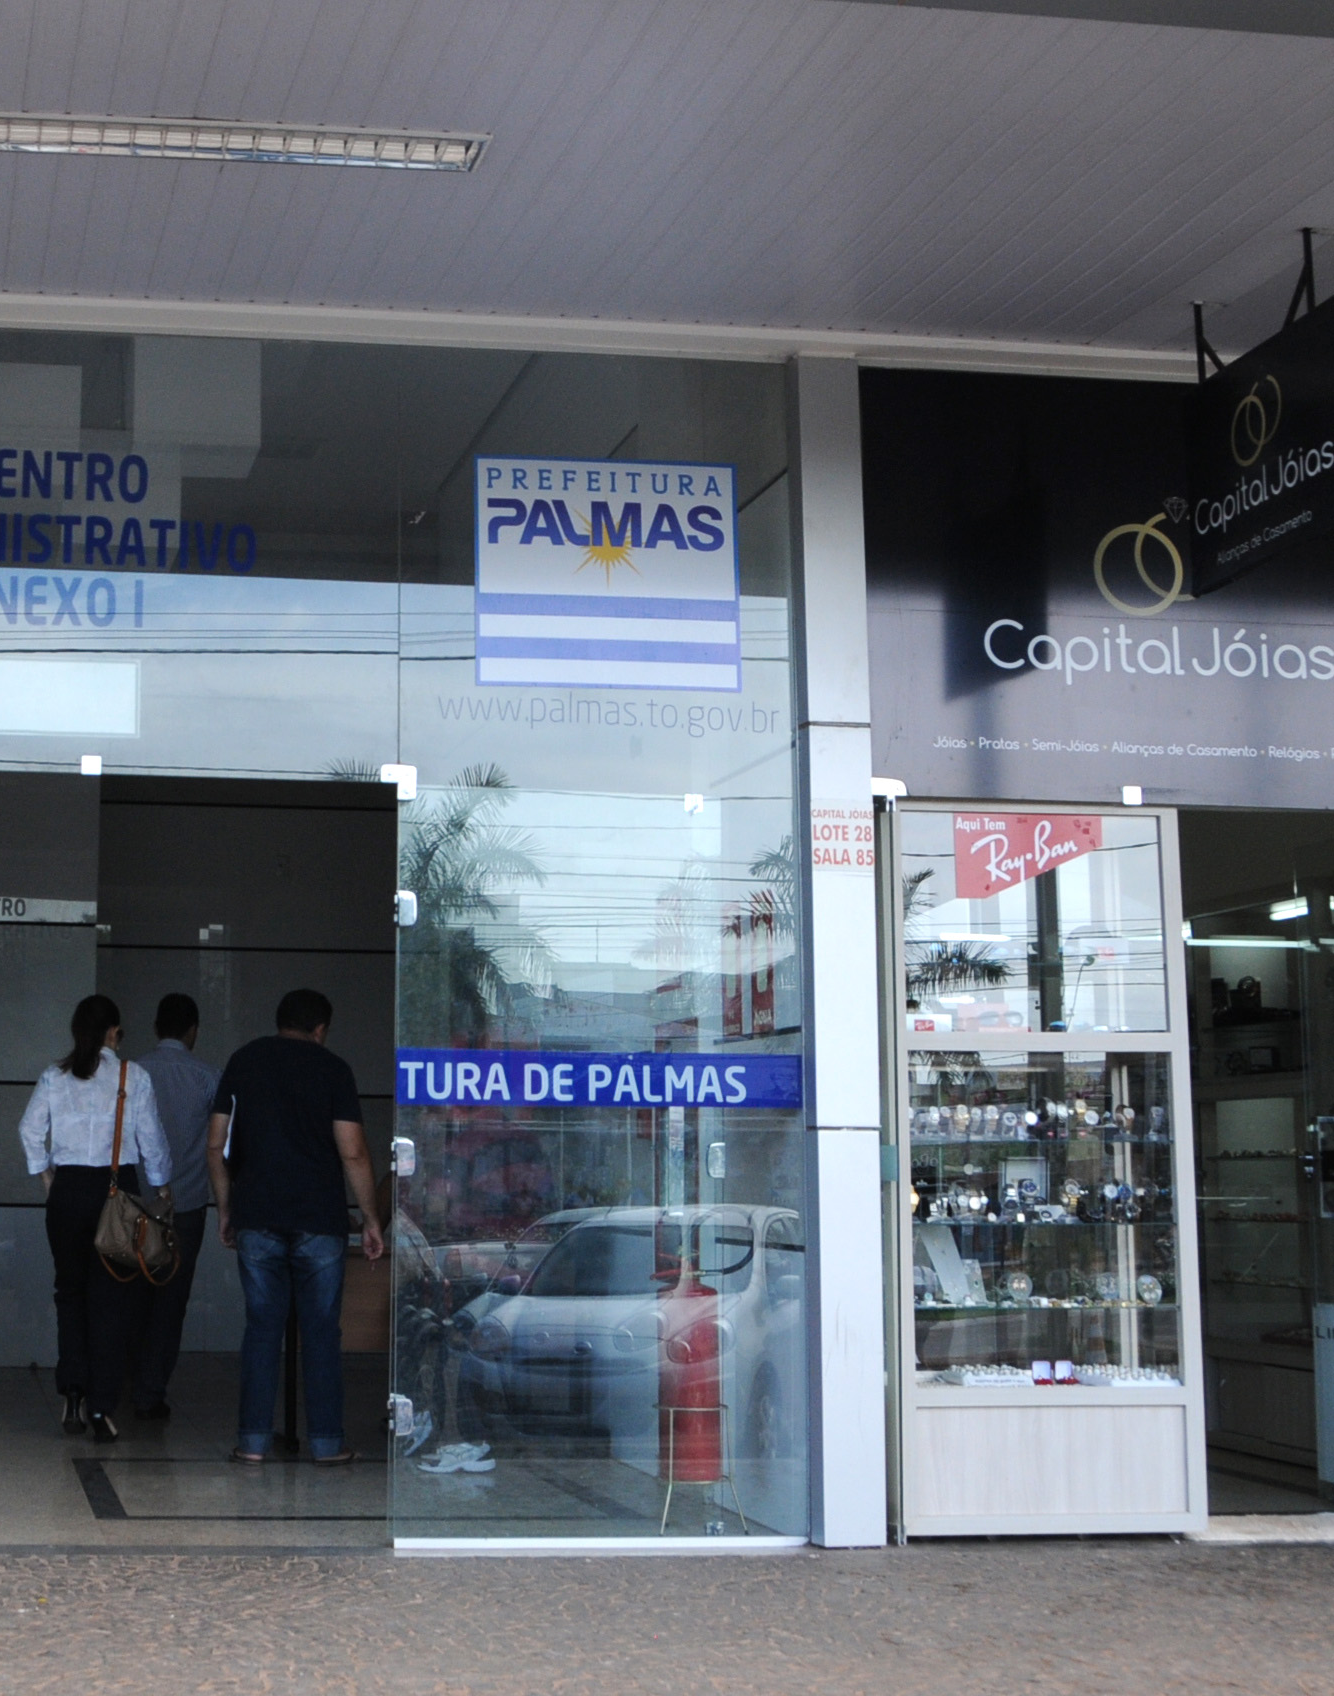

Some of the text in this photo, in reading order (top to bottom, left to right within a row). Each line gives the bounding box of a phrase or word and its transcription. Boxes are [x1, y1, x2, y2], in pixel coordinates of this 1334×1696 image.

[485, 467, 723, 498] PREFEITURA
[1195, 440, 1334, 535] Capital Jóias
[487, 498, 726, 552] PALMAS
[133, 580, 145, 628] I
[984, 619, 1334, 685] Capital Jóias
[437, 692, 780, 738] www.palmas.to.gov.br
[933, 737, 967, 749] Jóias
[979, 737, 1020, 751] Pratas
[1032, 739, 1099, 753] Semi-Jóias
[1112, 742, 1164, 758] Alianças
[1167, 744, 1183, 756] de
[1187, 744, 1257, 758] Casamento
[1269, 746, 1320, 762] Relógios
[811, 809, 846, 819] CAPITAL
[955, 817, 1006, 832] Aqui Tem
[813, 824, 873, 842] LOTE 28
[813, 848, 874, 866] SALA 85
[399, 1061, 747, 1104] TURA DE PALMAS
